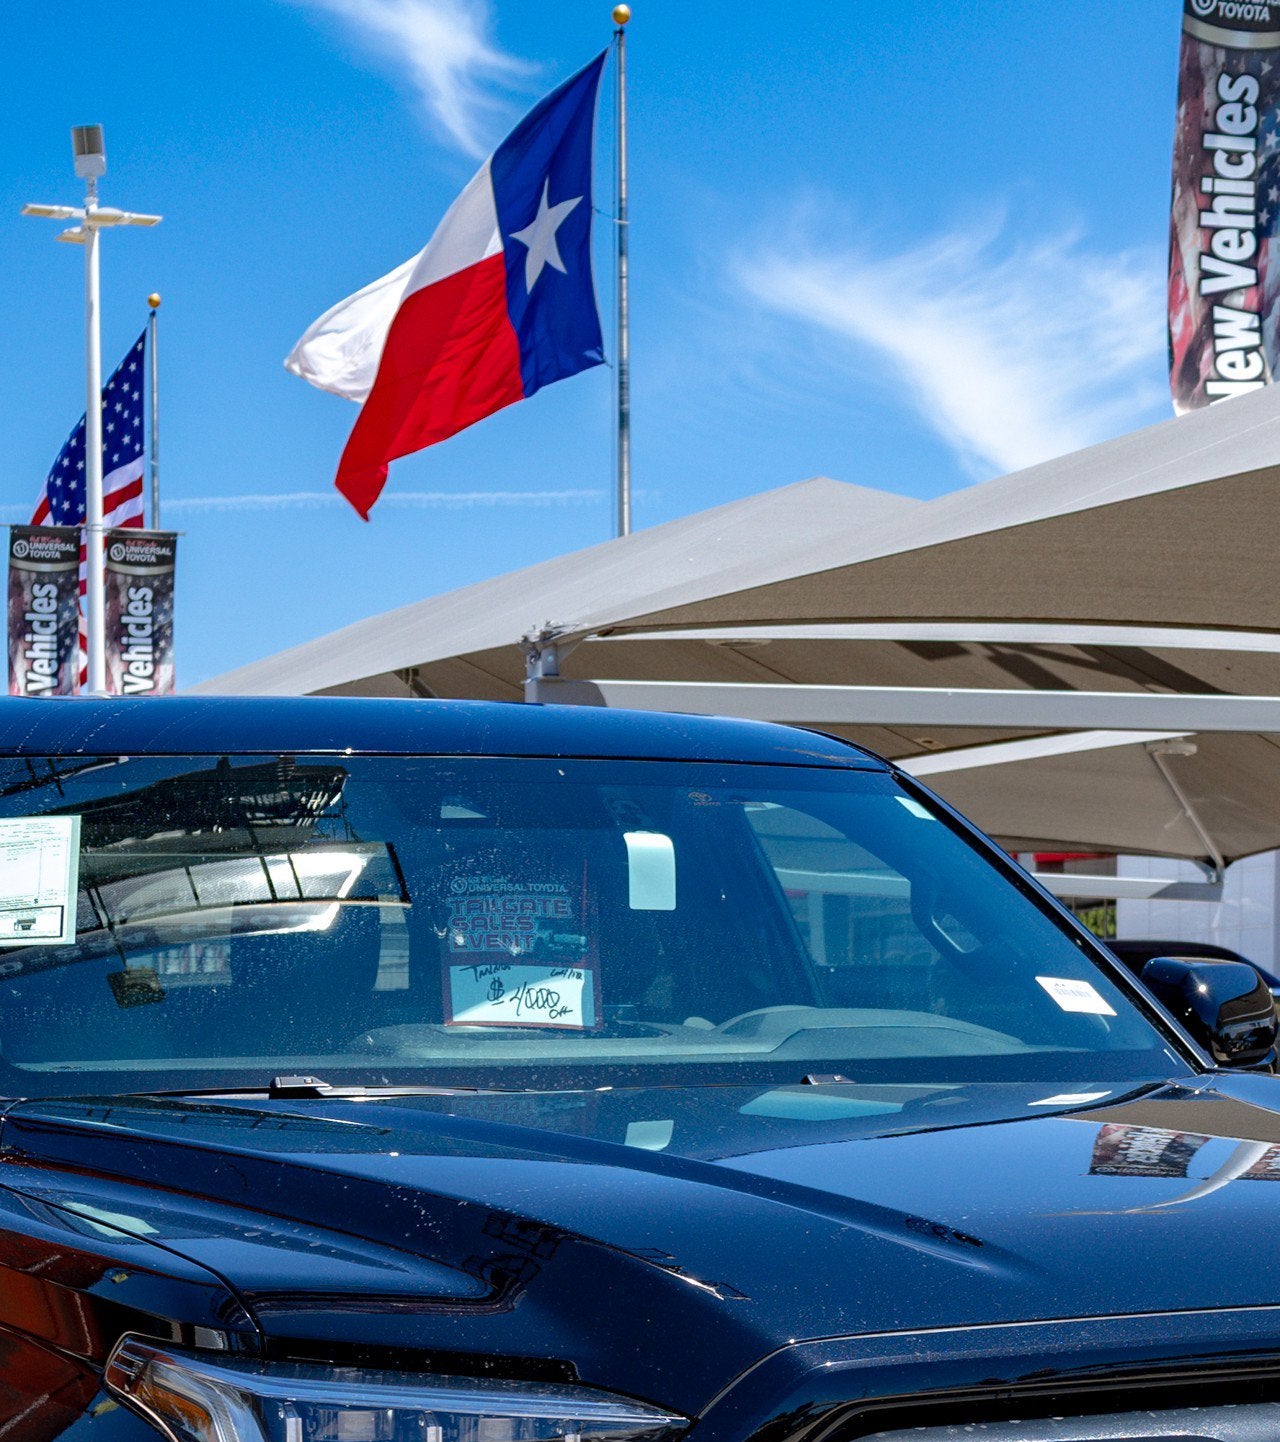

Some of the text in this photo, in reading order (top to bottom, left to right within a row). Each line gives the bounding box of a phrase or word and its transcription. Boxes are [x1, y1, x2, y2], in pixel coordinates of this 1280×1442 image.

[1217, 2, 1270, 21] TOYOTA
[1200, 73, 1260, 294] Vehicles
[30, 542, 76, 551] UNIVERSAL
[30, 550, 61, 558] TOYOTA
[125, 546, 172, 556] UNIVERSAL
[125, 554, 157, 562] TOYOTA
[25, 583, 58, 692] Vehicles
[121, 587, 154, 694] Vehicles
[470, 883, 567, 893] UNIVERSAL TOYOTA
[451, 898, 568, 915] TAILGATE
[451, 915, 534, 931] SALES
[453, 932, 535, 949] EVENT
